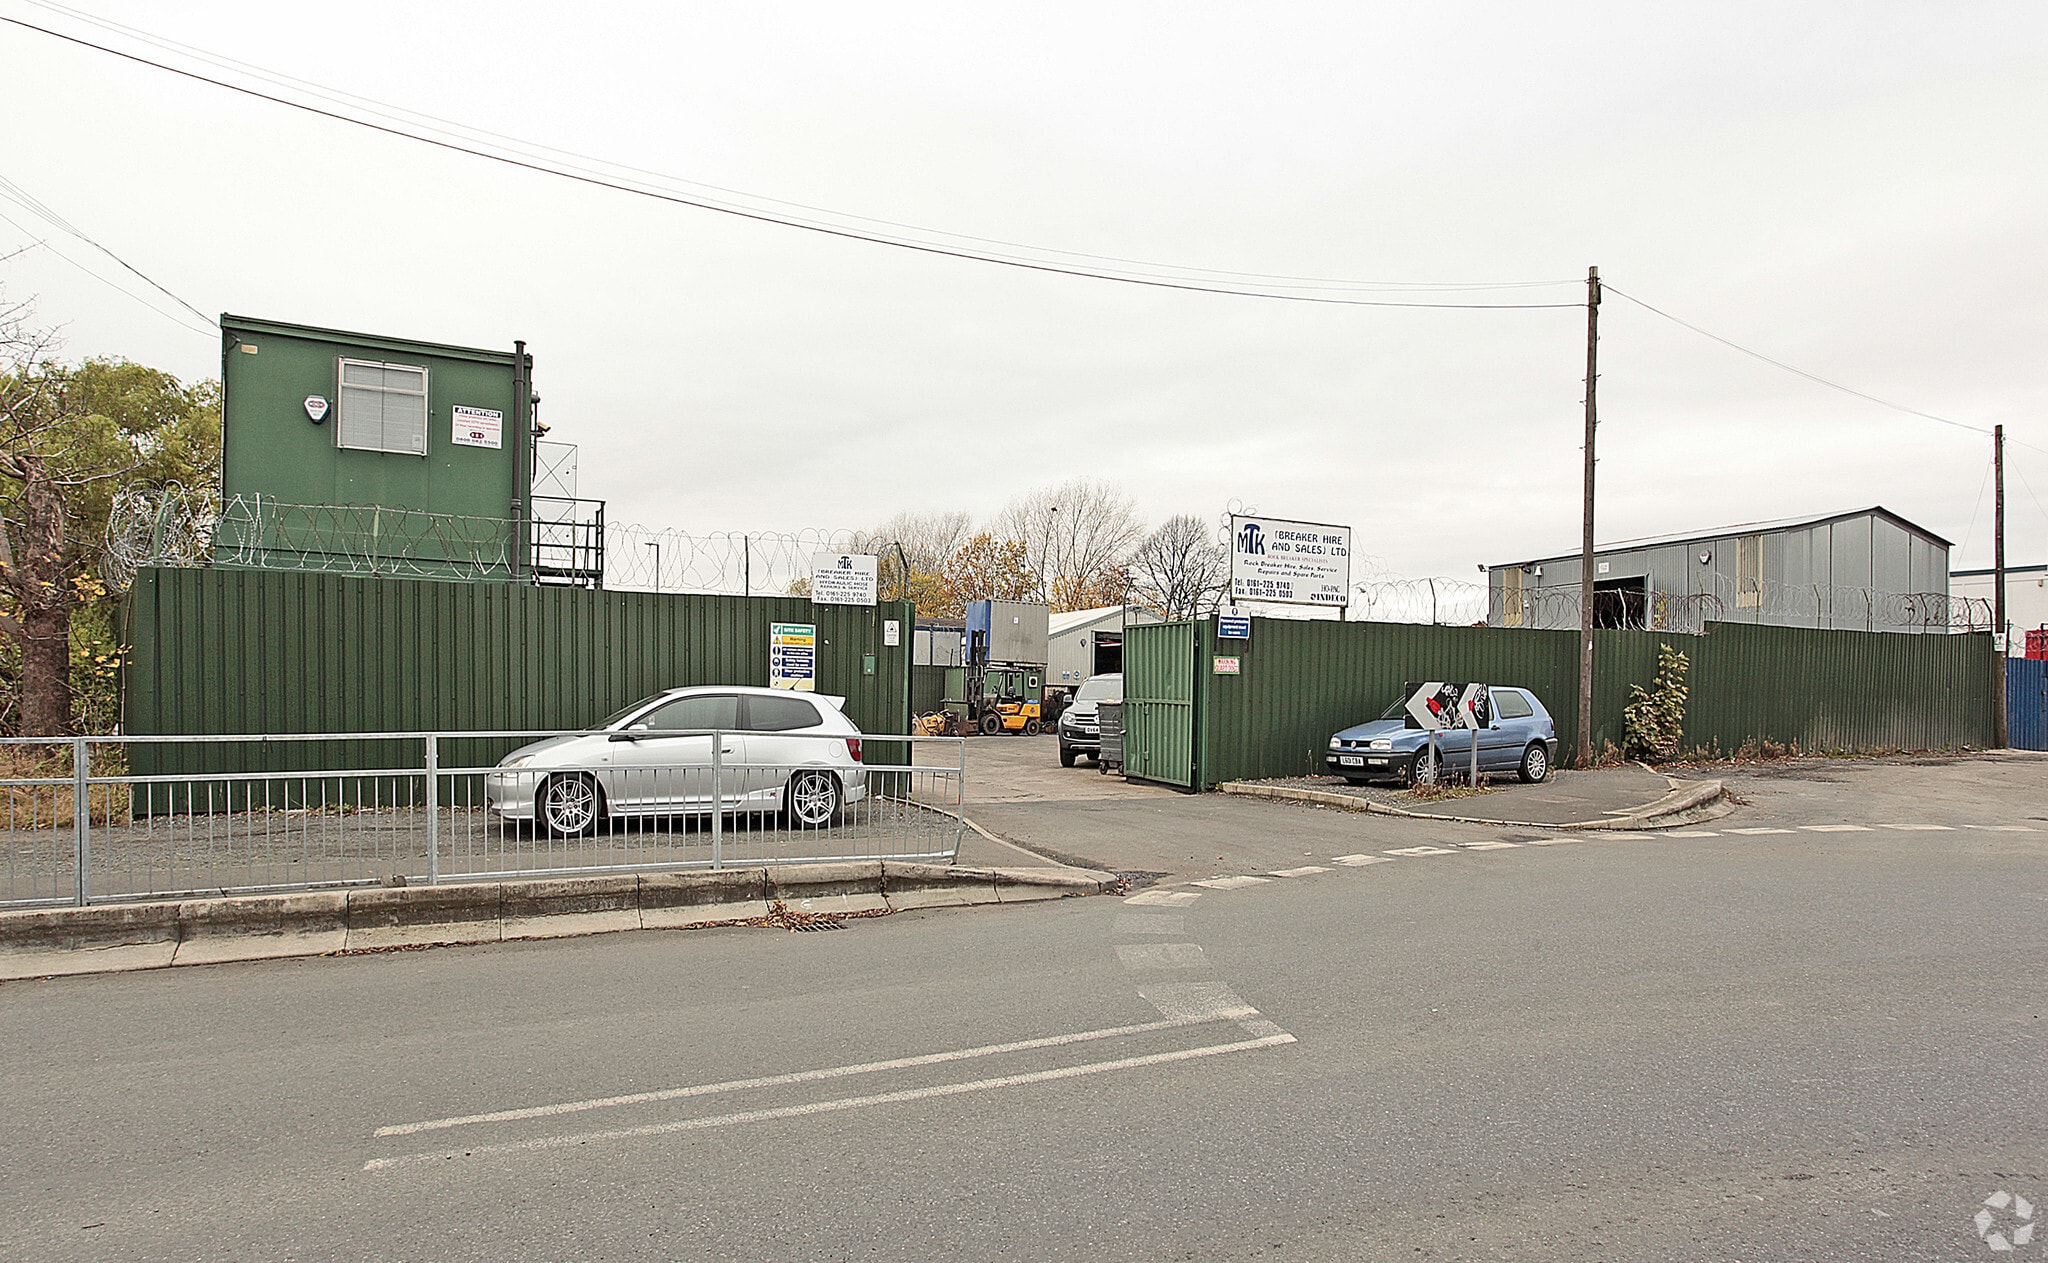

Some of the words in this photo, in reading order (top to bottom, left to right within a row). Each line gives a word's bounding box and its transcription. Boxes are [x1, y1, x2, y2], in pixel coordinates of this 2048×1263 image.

[458, 408, 498, 417] ATTENTION
[1237, 524, 1265, 555] MTK
[1275, 530, 1318, 543] (BREAKER
[1323, 535, 1342, 545] HIRE
[1272, 542, 1290, 551] AND
[1295, 544, 1326, 555] SALES)
[1331, 547, 1347, 556] LTD
[838, 556, 852, 569] MTK
[1247, 579, 1274, 588] 0161-225
[1250, 588, 1276, 597] 0161-225
[1279, 590, 1292, 598] 0503
